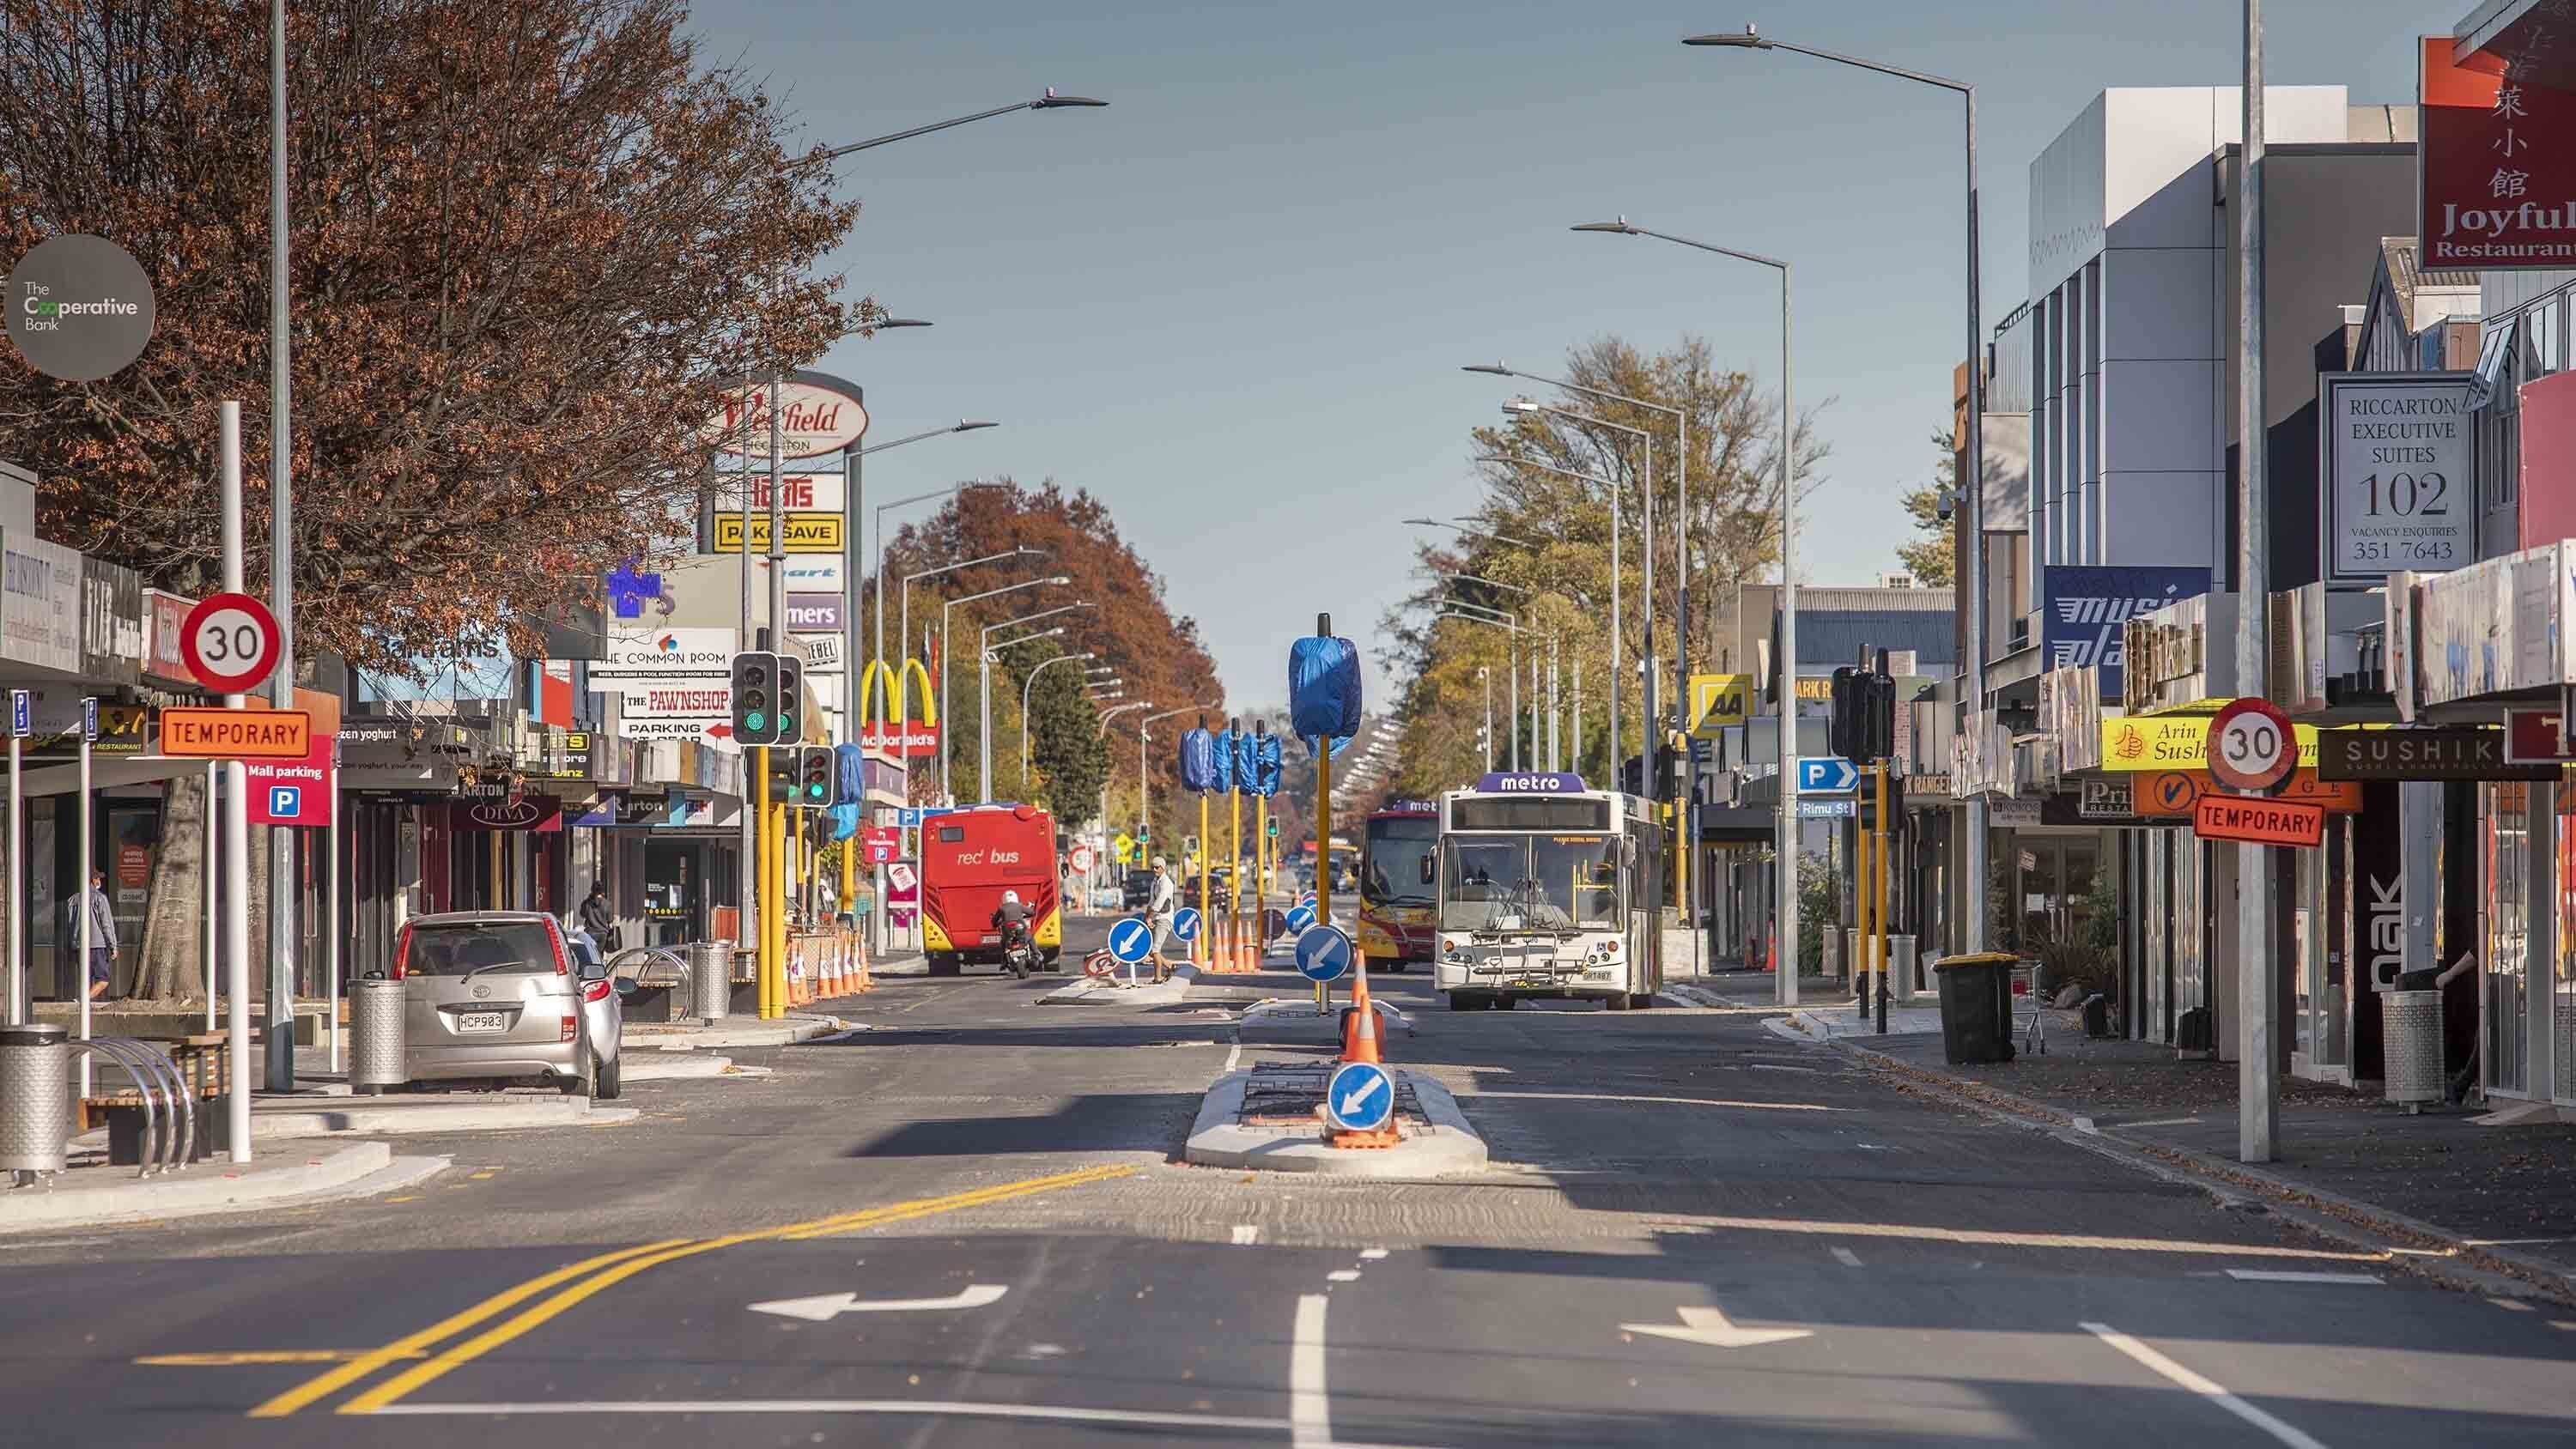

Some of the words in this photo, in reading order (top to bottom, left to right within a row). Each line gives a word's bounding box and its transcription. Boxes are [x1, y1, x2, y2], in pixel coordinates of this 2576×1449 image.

[25, 282, 50, 295] The
[26, 318, 59, 330] Bank
[2350, 397, 2458, 415] RICCARTON
[2352, 422, 2456, 440] EXECUTIVE
[2372, 446, 2436, 464] SUITES
[2360, 472, 2449, 517] 102
[2350, 527, 2400, 537] VACANCY
[2403, 527, 2458, 539] ENQUIRIES
[2353, 542, 2391, 560] 351
[2401, 542, 2452, 560] 7643
[783, 569, 837, 578] art
[205, 625, 258, 661] 30
[808, 640, 836, 660] EBEL
[627, 652, 685, 665] COMMON
[690, 652, 726, 665] ROOM
[627, 697, 647, 706] THE
[649, 690, 729, 711] PAWNSHOP
[1709, 693, 1742, 716] AA
[173, 722, 300, 745] TEMPORARY
[360, 728, 398, 741] yoghurt
[629, 724, 701, 734] PARKING
[2157, 723, 2197, 739] Arin
[2227, 726, 2276, 761] 30
[2346, 741, 2494, 761] SUSHIK
[248, 765, 274, 777] Mall
[276, 765, 323, 780] parking
[1808, 764, 1826, 785] P
[1501, 775, 1560, 791] metro
[276, 791, 295, 812] P
[1802, 801, 1832, 815] Rimu
[1836, 802, 1849, 815] St
[484, 807, 526, 822] DIVA
[2202, 806, 2316, 834] TEMPORARY
[957, 848, 984, 865] red
[990, 847, 1019, 864] bus
